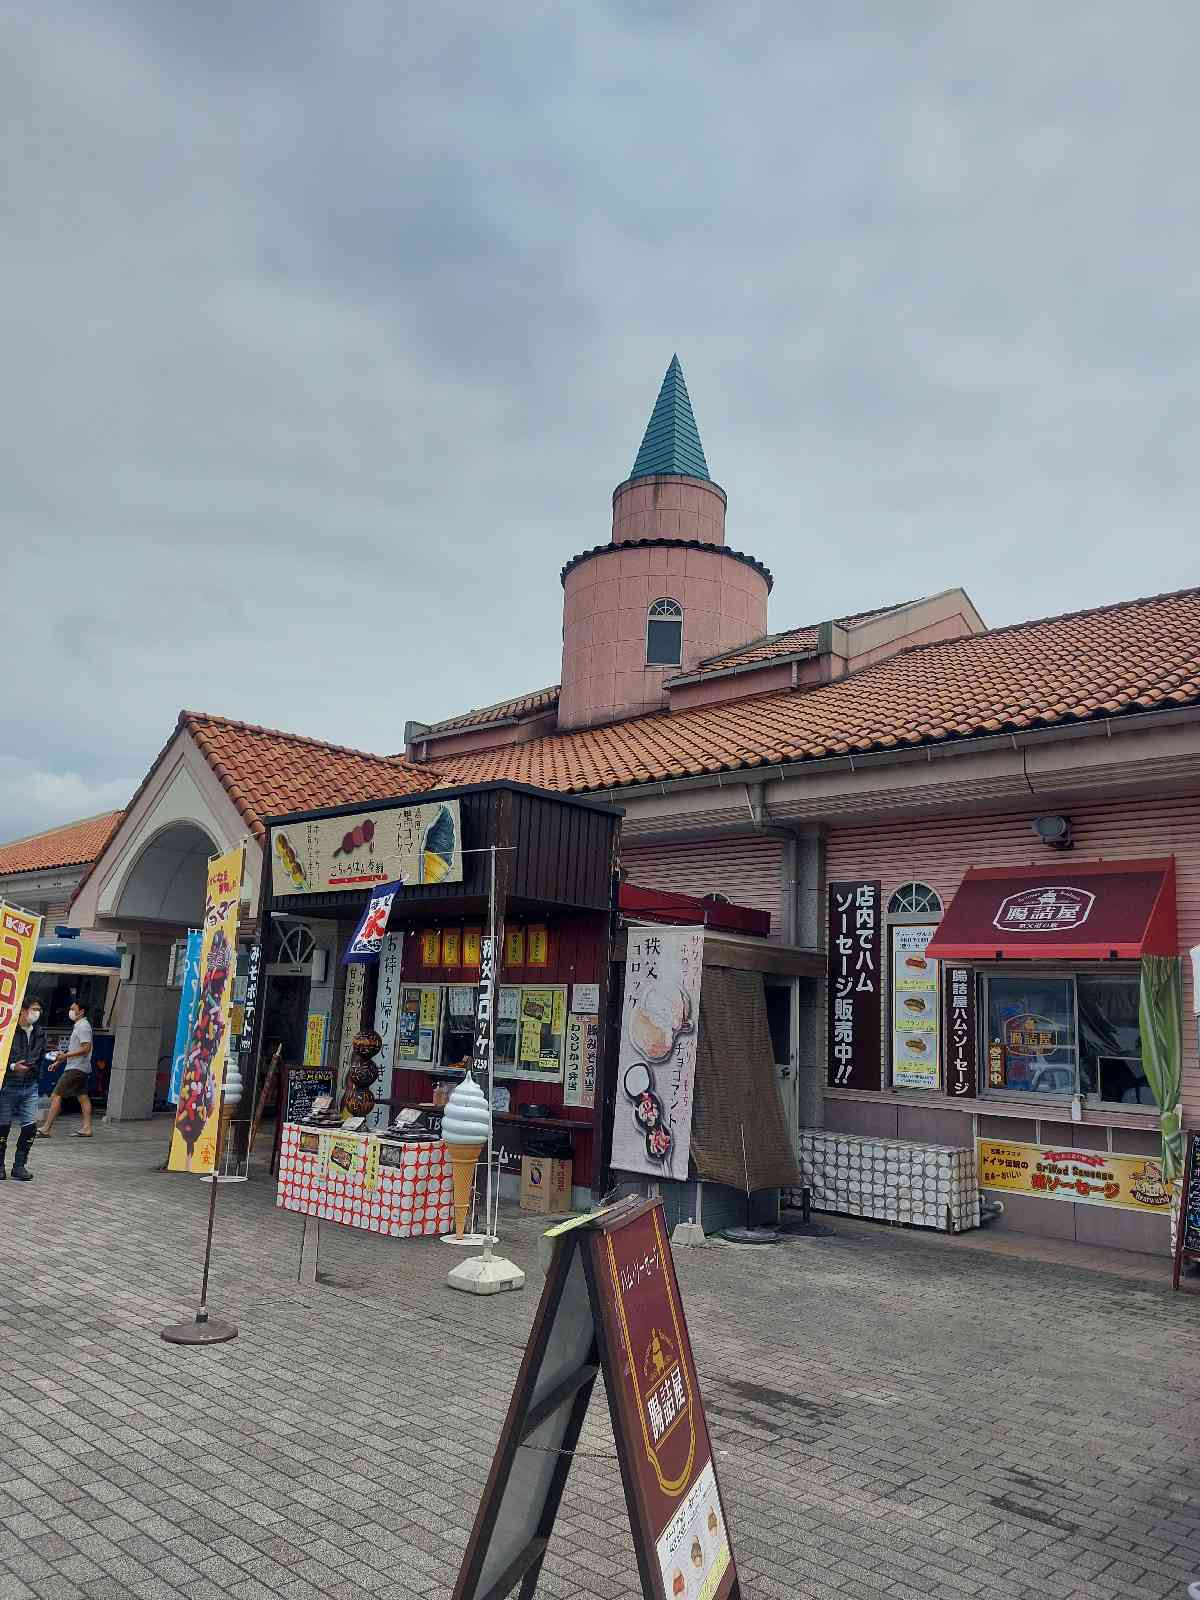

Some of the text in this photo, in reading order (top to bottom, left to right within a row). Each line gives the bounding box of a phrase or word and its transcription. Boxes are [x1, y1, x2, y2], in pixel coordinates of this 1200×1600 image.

[628, 943, 641, 1009] コロッケ
[644, 936, 661, 980] 秩父
[855, 884, 875, 993] 店内でハム
[243, 946, 260, 1037] みそポテト
